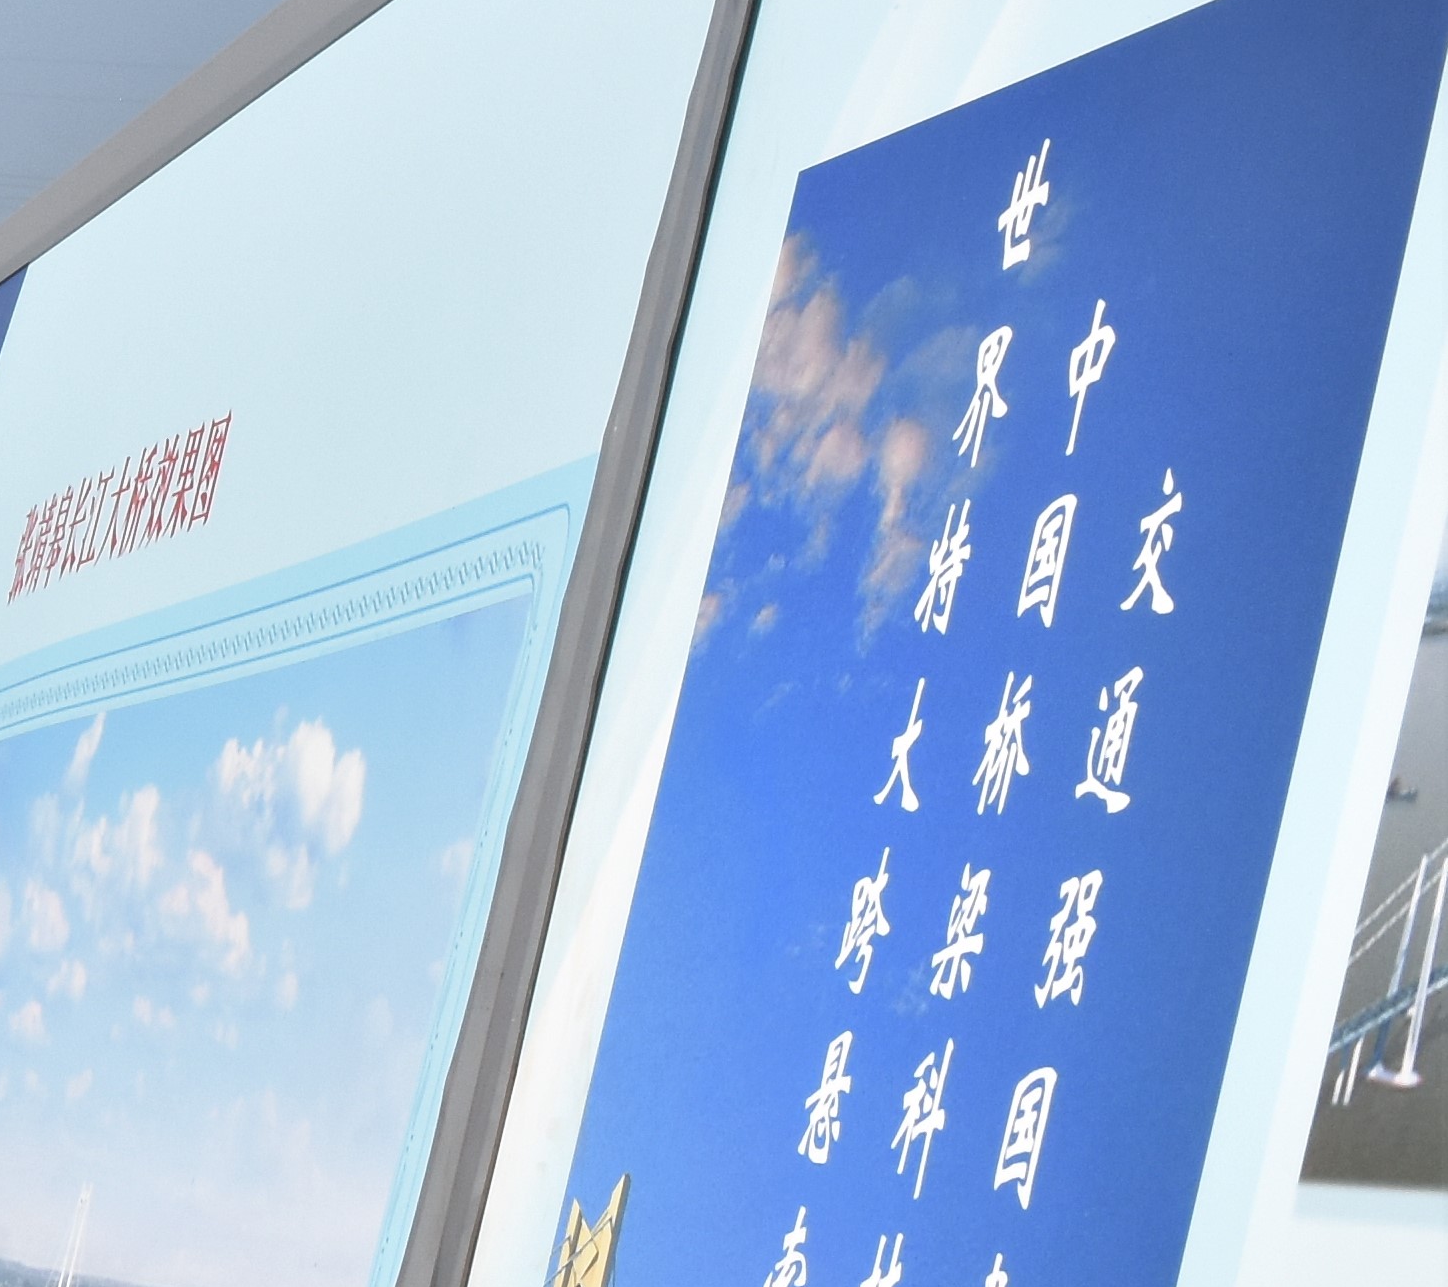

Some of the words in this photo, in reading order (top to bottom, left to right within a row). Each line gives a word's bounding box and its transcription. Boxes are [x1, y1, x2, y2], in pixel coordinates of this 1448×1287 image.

[7, 409, 231, 606] 张靖皋长江大桥效果图
